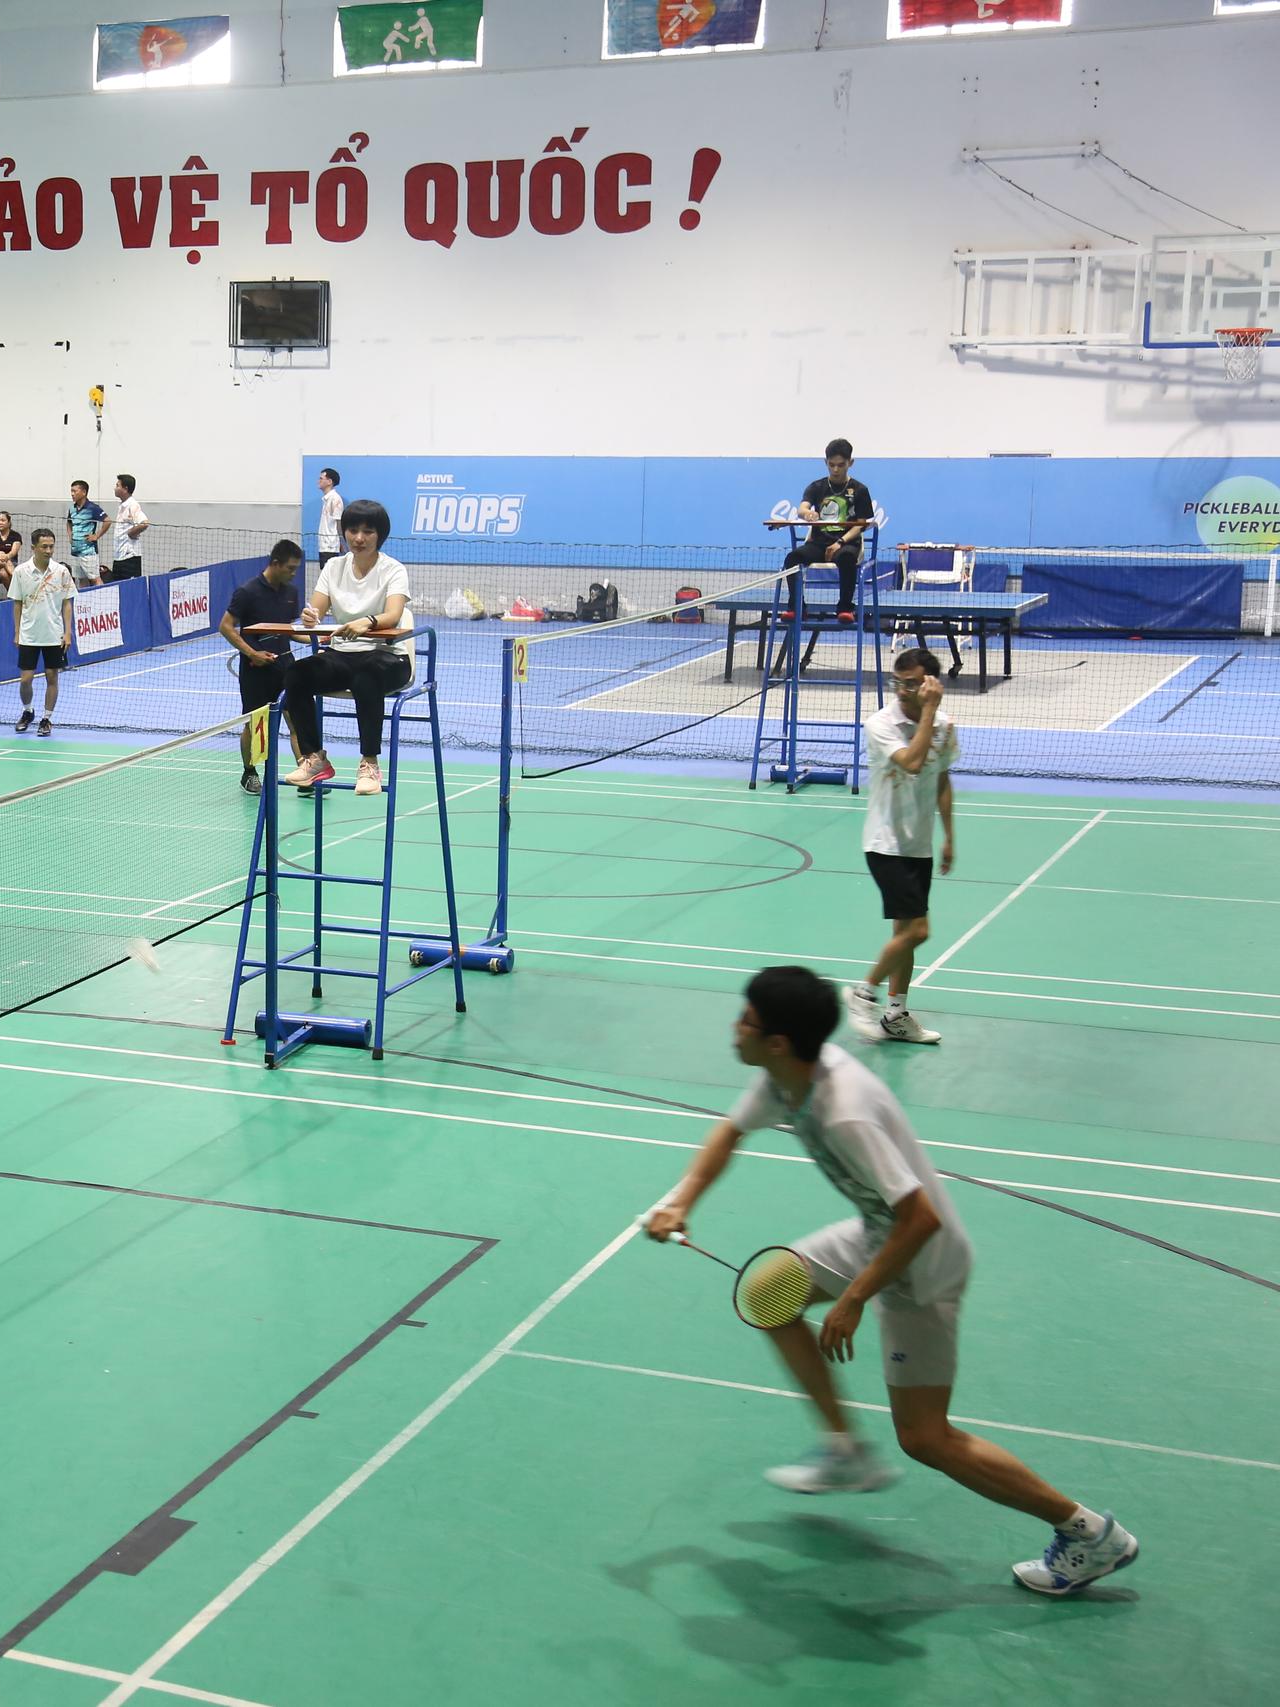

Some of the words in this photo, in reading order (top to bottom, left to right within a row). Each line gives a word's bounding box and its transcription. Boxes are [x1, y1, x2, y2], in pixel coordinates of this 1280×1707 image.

[111, 155, 220, 265] VỆ
[251, 131, 370, 245] TỔ
[404, 127, 653, 250] QUỐC
[416, 474, 454, 484] ACTIVE
[412, 494, 526, 536] HOOPS
[1183, 502, 1280, 515] PICKLEBALL
[517, 644, 525, 676] 2
[255, 715, 265, 754] 1
